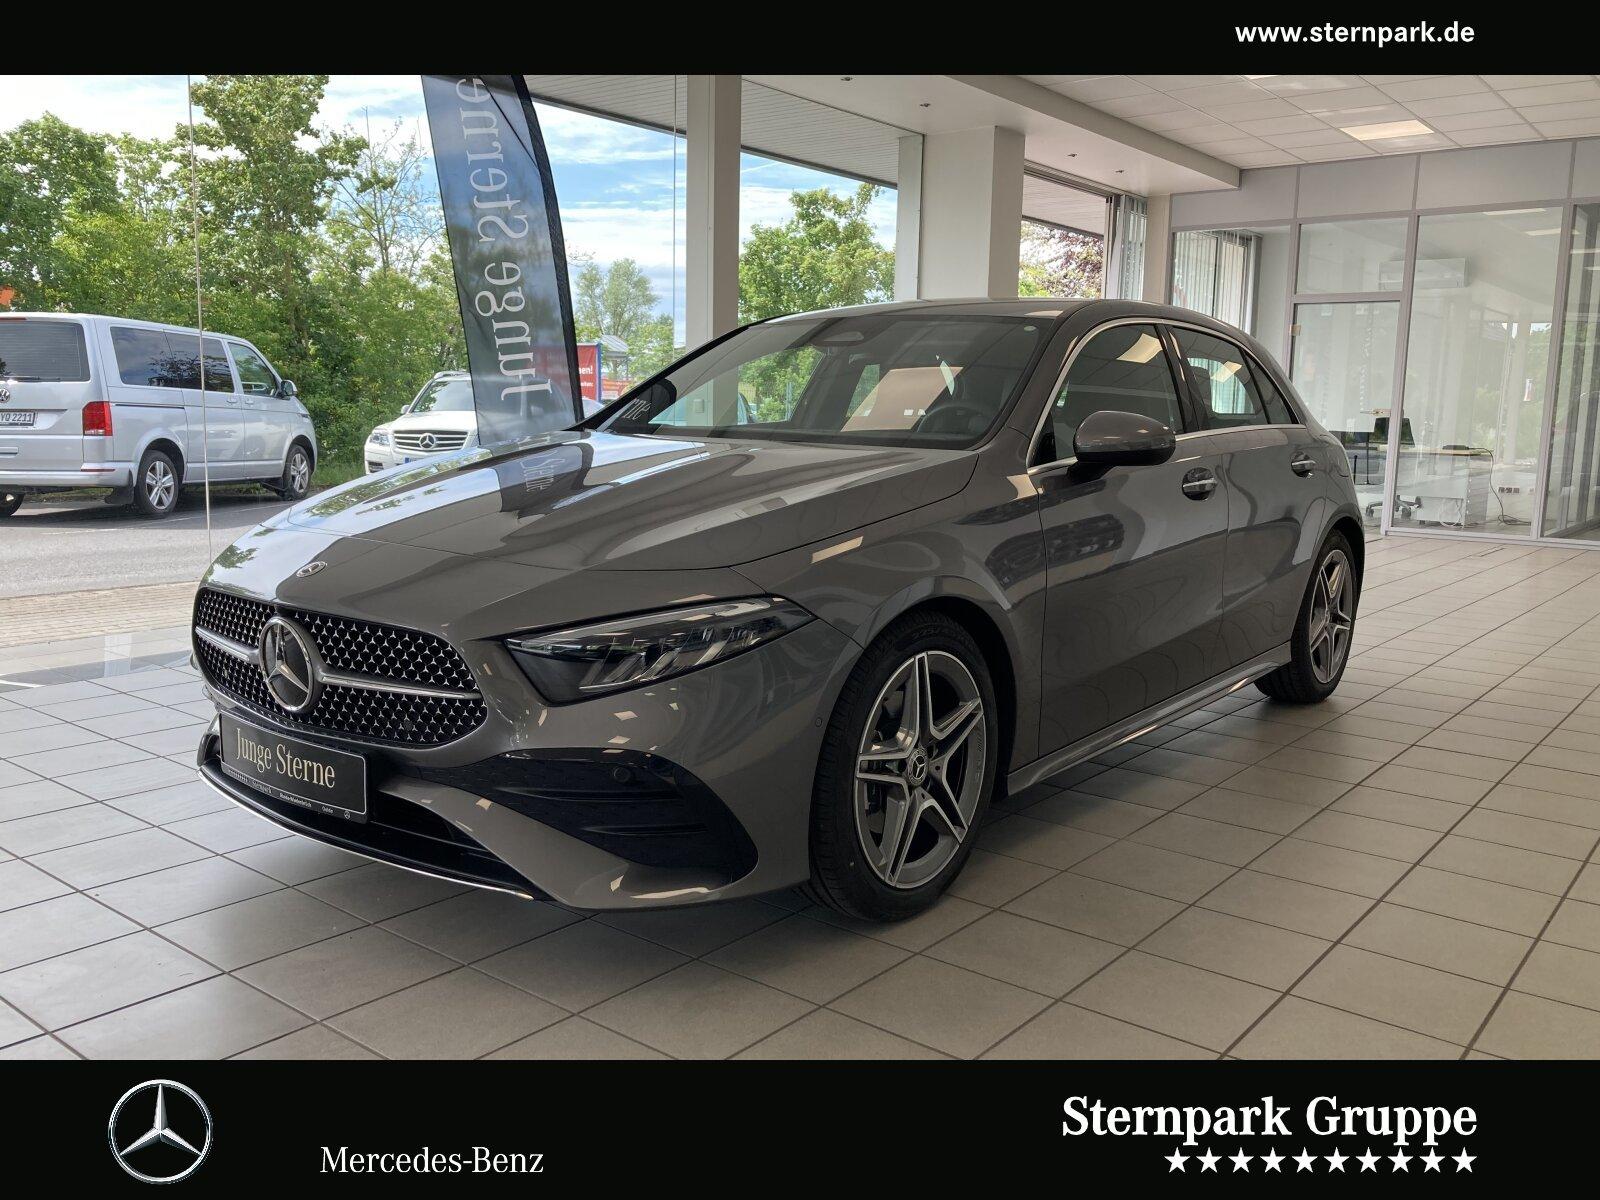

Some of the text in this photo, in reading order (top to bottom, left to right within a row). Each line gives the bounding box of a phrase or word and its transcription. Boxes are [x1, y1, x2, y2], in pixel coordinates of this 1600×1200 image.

[12, 413, 32, 423] 2211
[236, 727, 335, 789] Junge Sterne
